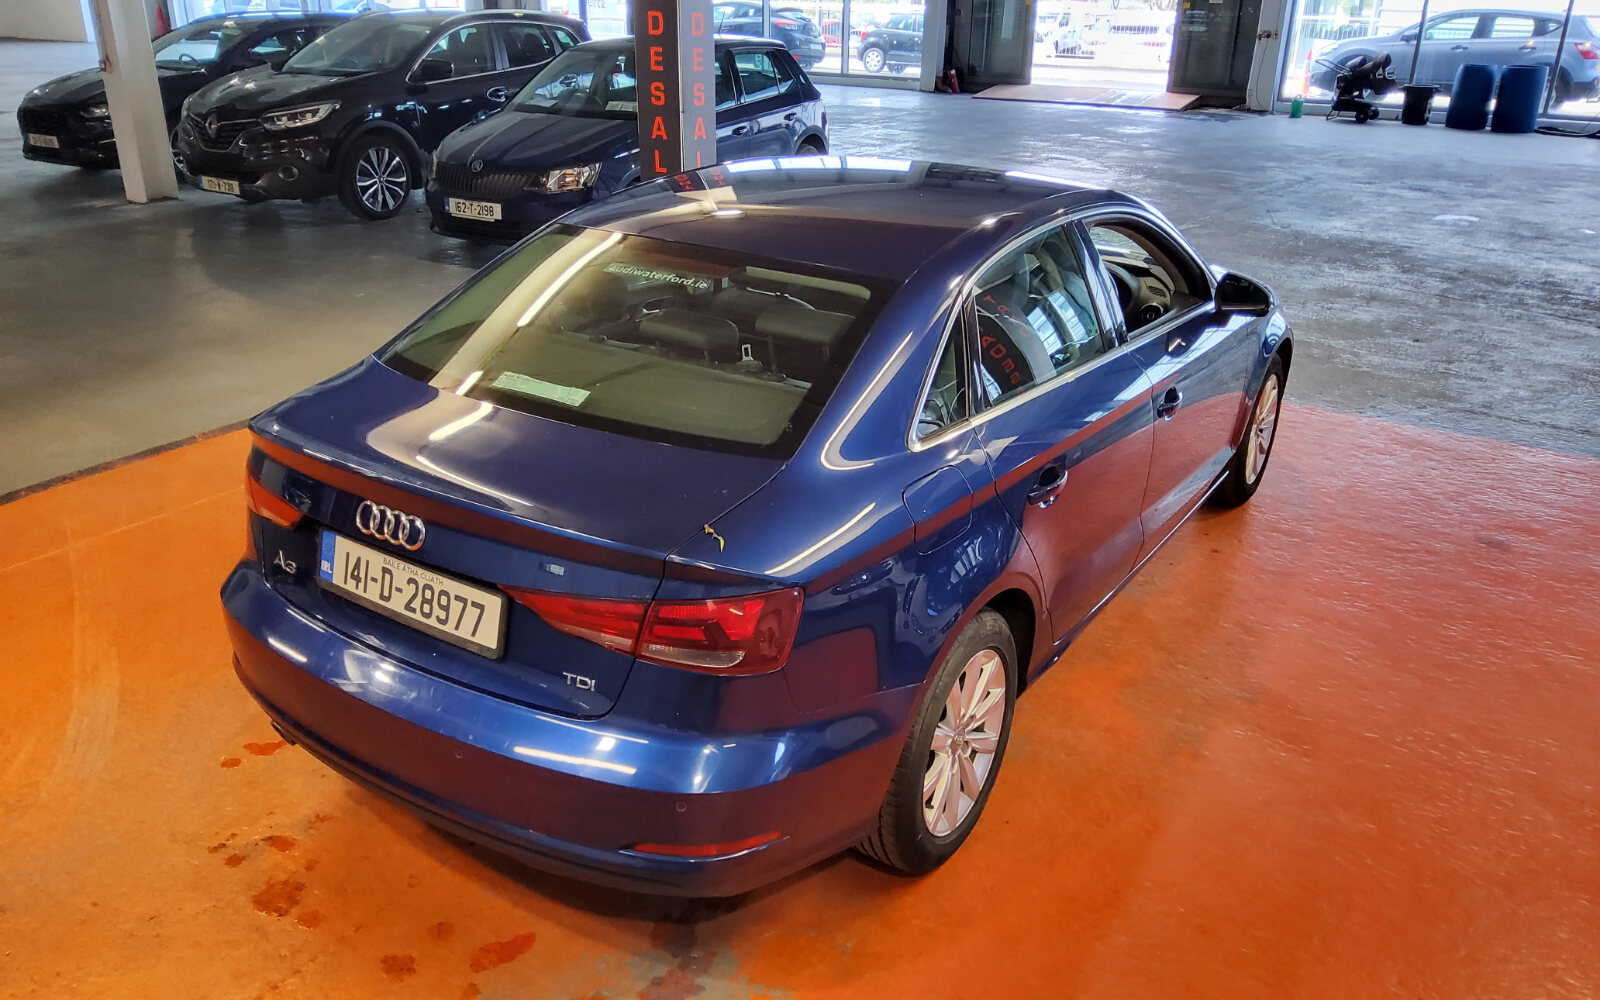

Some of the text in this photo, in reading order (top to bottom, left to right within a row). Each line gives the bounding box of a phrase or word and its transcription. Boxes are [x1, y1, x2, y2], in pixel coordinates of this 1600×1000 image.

[454, 200, 495, 217] 162-T-2198
[273, 549, 297, 575] A3
[320, 559, 333, 575] IRL
[382, 557, 401, 570] BAILE
[420, 572, 444, 587] CLIATH
[343, 551, 486, 638] 141-D-28977
[562, 671, 596, 692] TDI
